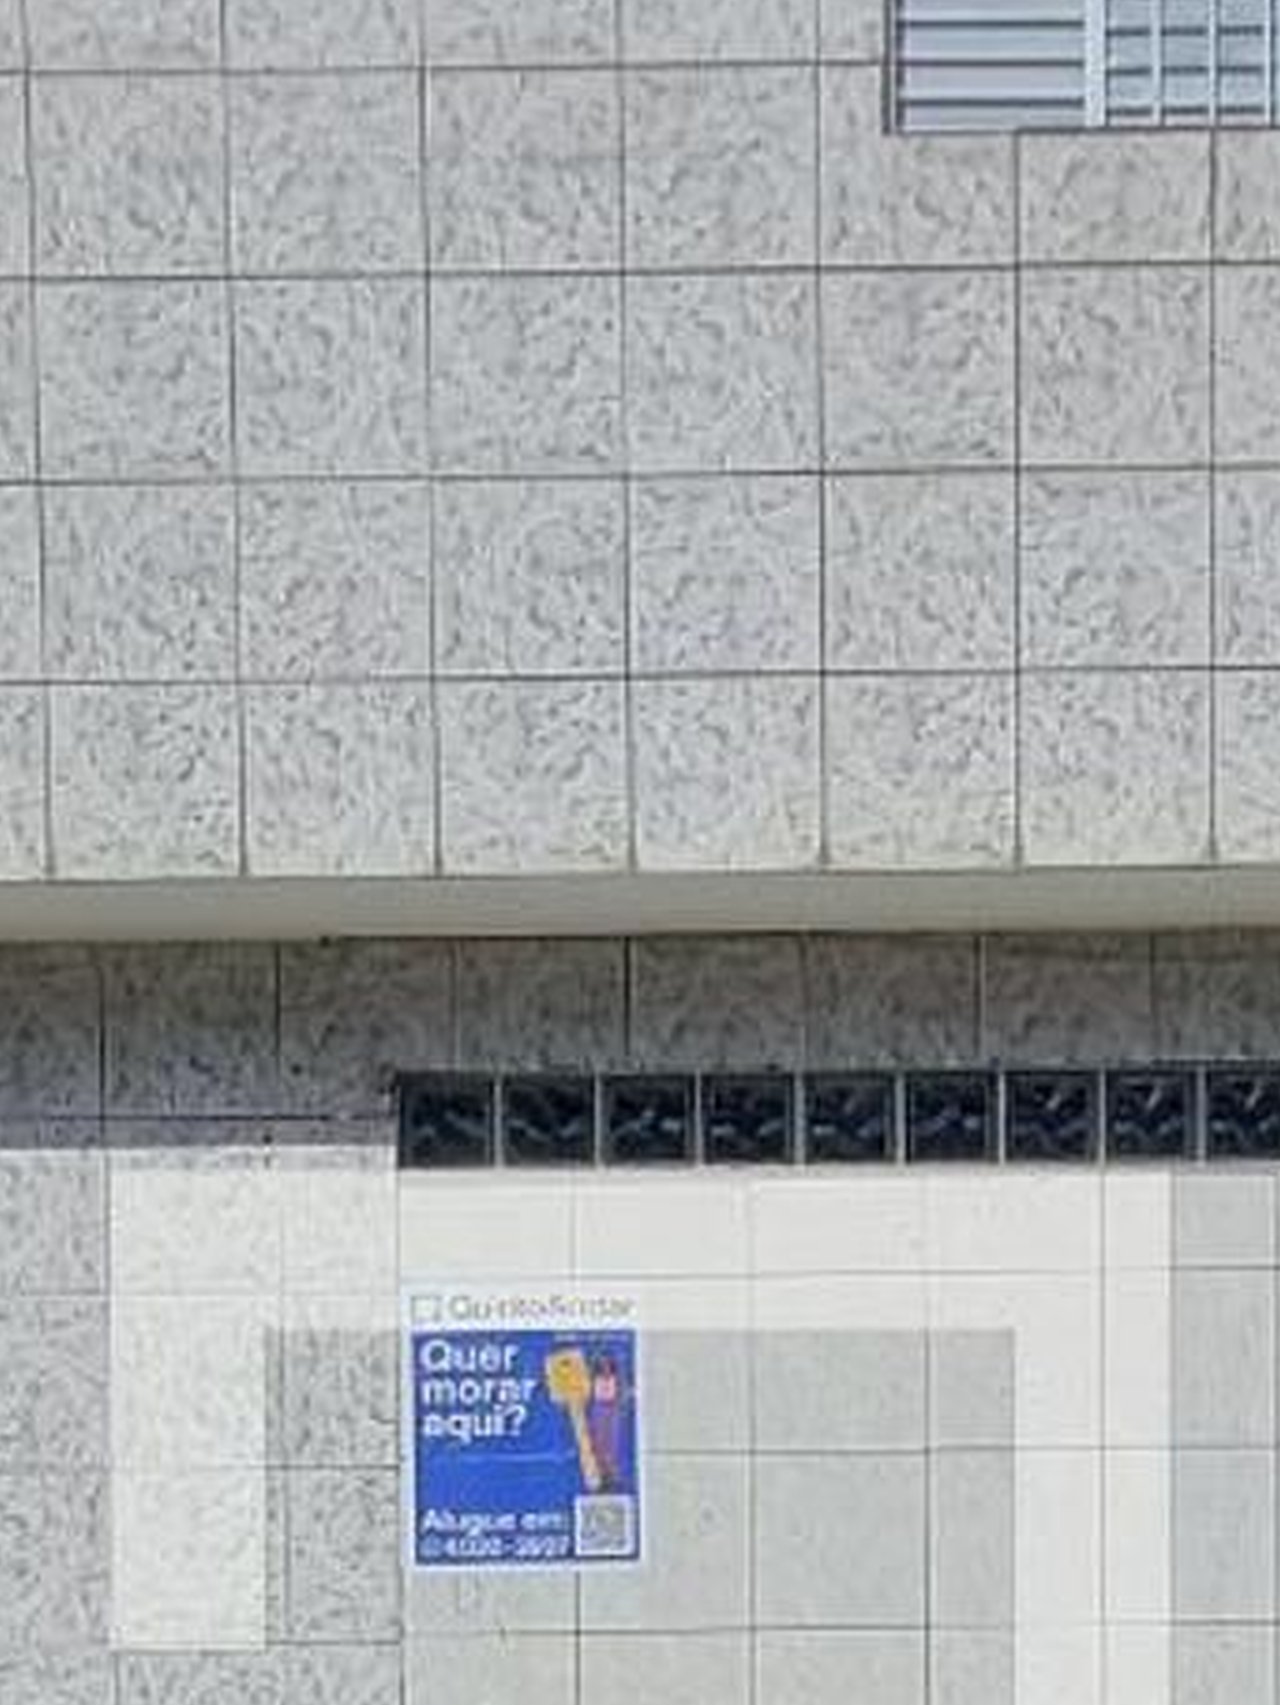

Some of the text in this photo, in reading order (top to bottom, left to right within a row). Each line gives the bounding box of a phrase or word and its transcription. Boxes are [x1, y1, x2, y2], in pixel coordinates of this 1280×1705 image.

[419, 1339, 520, 1370] Quer
[421, 1379, 536, 1406] morar
[421, 1405, 526, 1442] aqui?
[420, 1508, 517, 1537] Alugue
